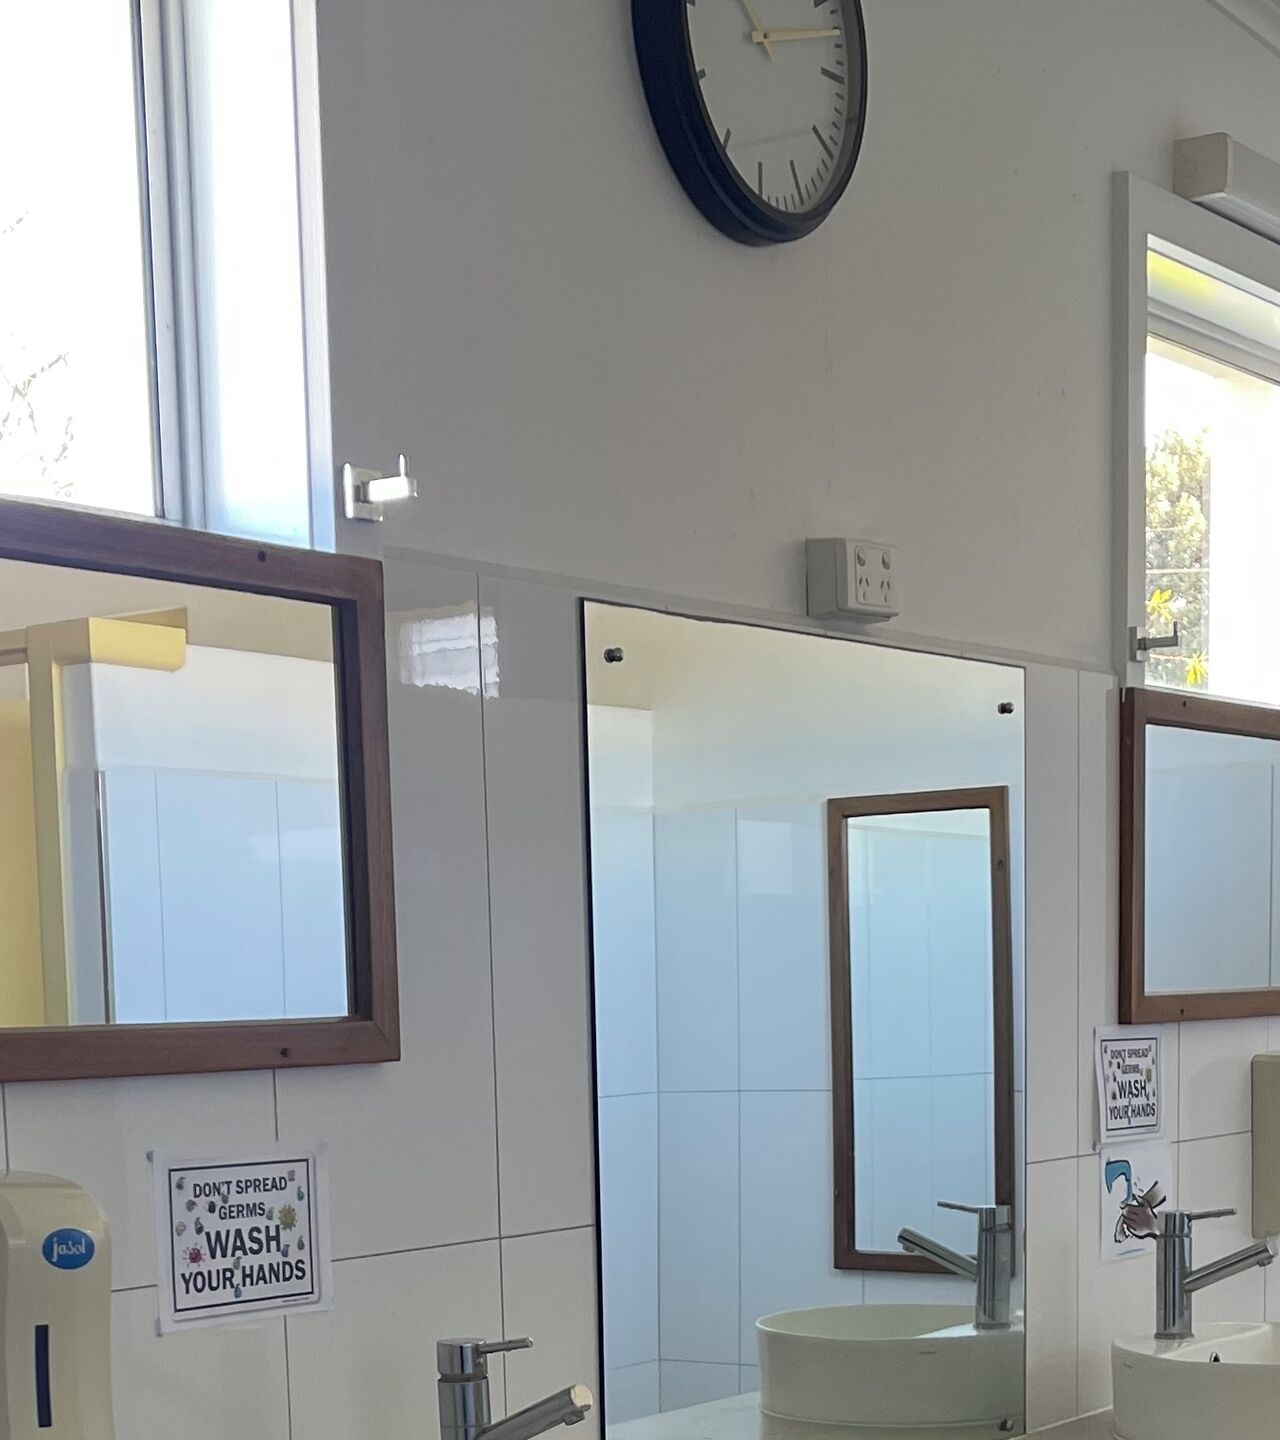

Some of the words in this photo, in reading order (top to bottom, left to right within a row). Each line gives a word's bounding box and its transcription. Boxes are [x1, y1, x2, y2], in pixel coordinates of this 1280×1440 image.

[1117, 1079, 1147, 1100] WASH
[1109, 1105, 1129, 1120] YOUR
[1130, 1102, 1155, 1118] HANDS
[193, 1180, 232, 1198] DON'T
[235, 1176, 287, 1195] SPREAD
[218, 1202, 266, 1220] GERMS
[52, 1237, 86, 1262] jasol
[205, 1224, 282, 1260] WASH
[181, 1267, 235, 1294] YOUR
[242, 1259, 307, 1288] HANDS
